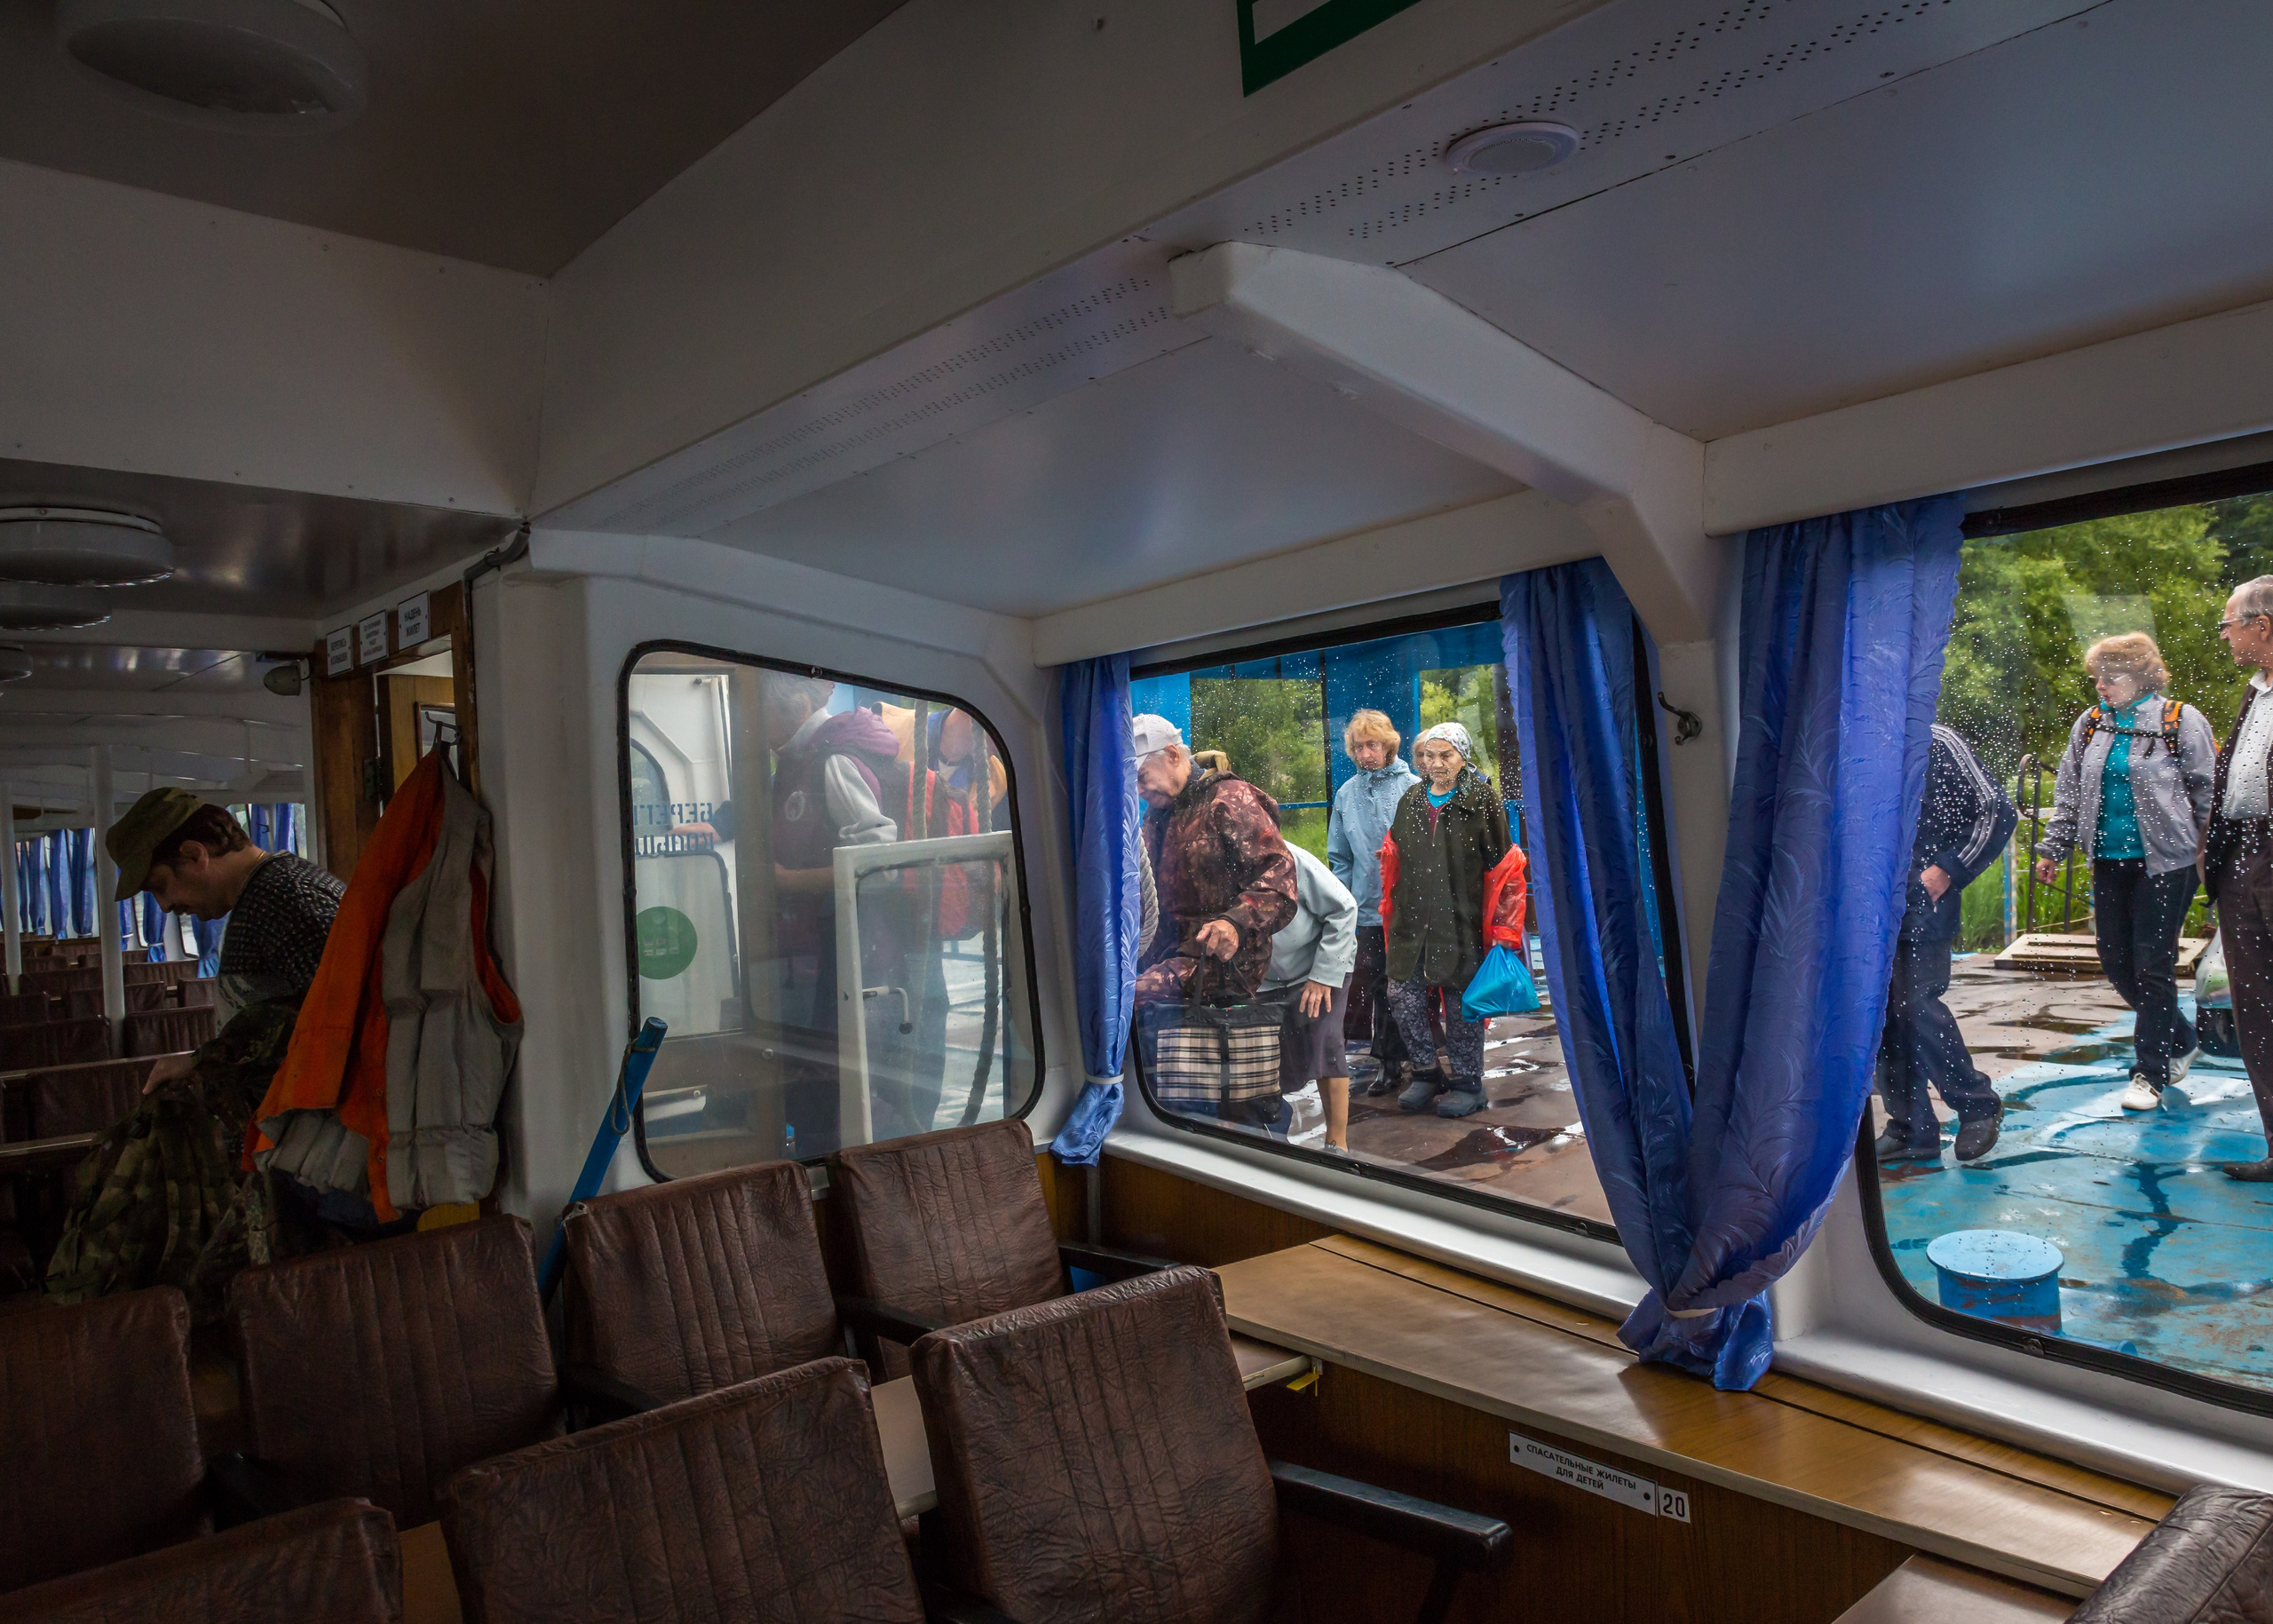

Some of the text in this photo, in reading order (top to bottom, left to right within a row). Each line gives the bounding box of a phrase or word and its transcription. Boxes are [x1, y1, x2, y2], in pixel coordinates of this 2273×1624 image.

[1526, 1444, 1636, 1490] СПАСАТЕЛЬНЫЕ ЖИЛЕТЫ
[1556, 1466, 1604, 1490] ДЛЯ ДЕТЕЙ
[1662, 1493, 1685, 1517] 20
